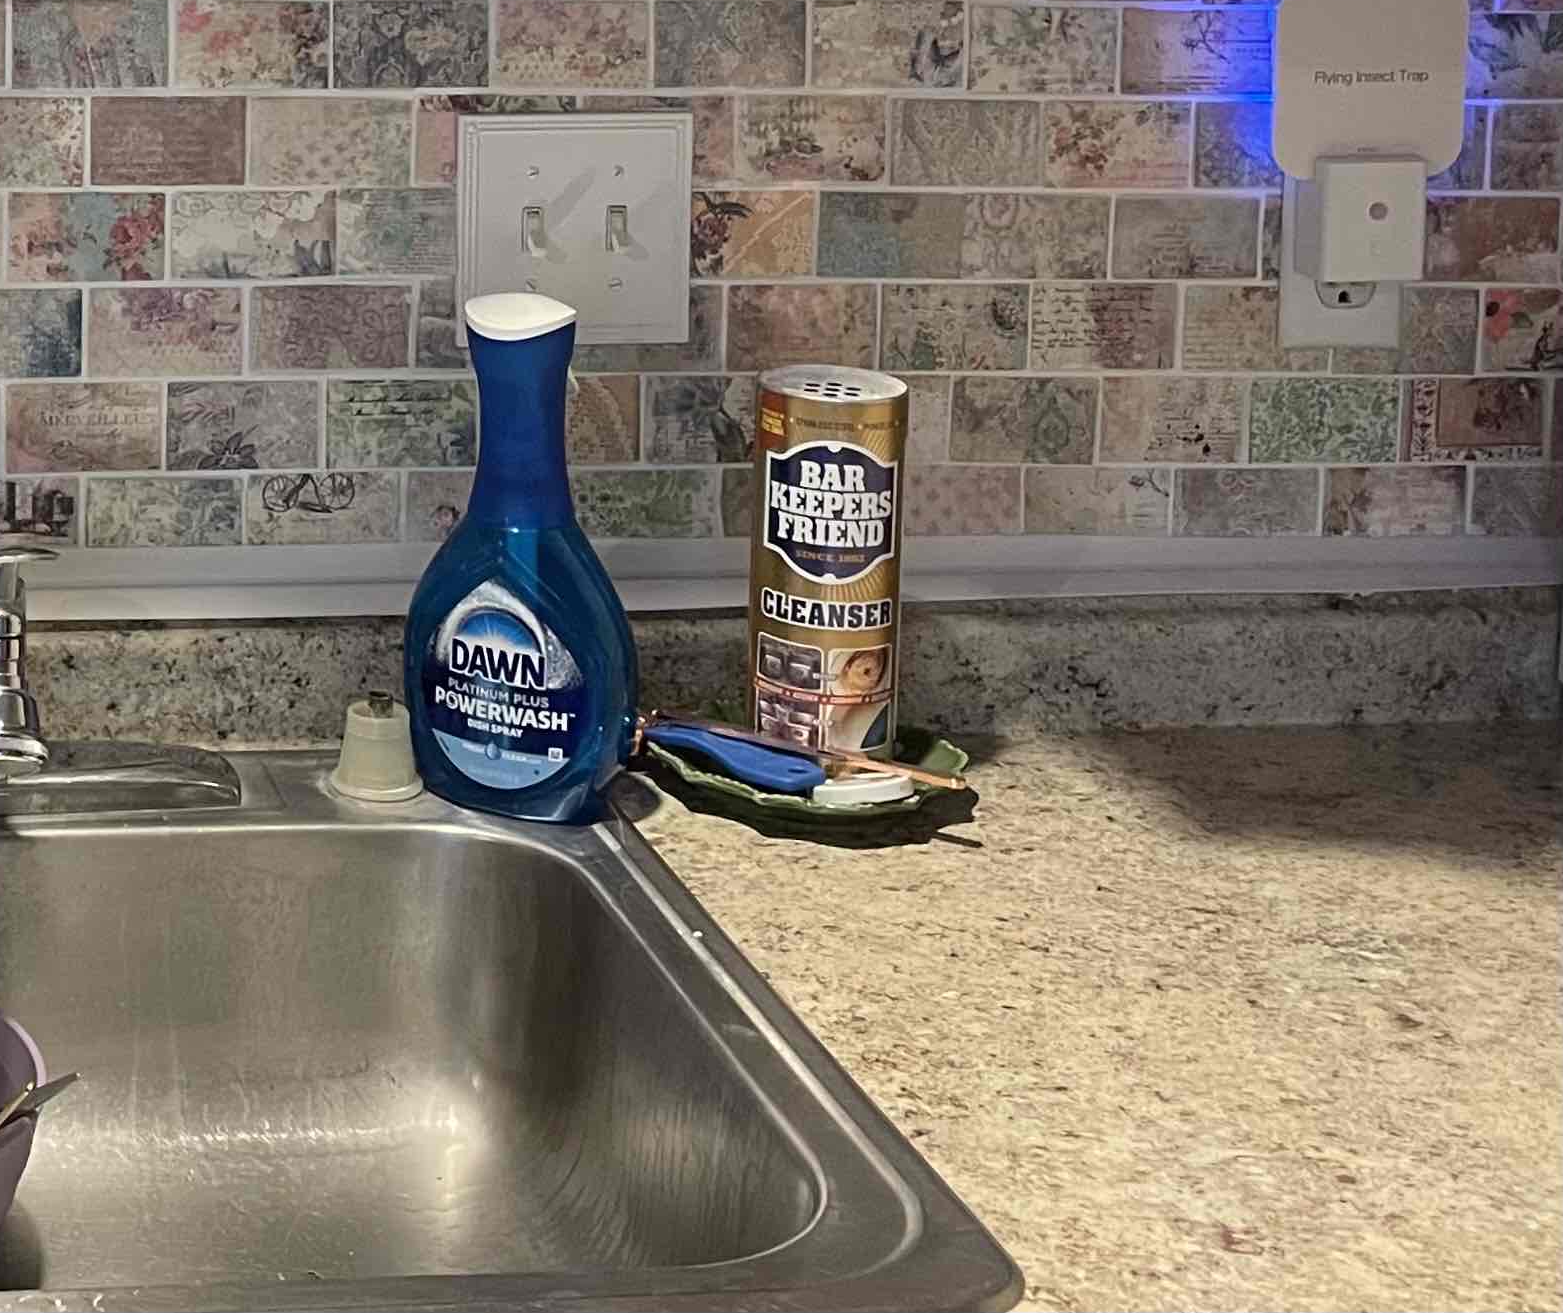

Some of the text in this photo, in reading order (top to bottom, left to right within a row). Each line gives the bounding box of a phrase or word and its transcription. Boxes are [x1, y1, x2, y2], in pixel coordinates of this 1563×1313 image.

[1314, 69, 1429, 86] Flying Insect Trap
[799, 460, 866, 492] BAR
[770, 480, 892, 520] KEEPERS
[777, 510, 885, 548] FRIEND
[762, 587, 892, 630] CLEANSER
[450, 636, 547, 690] DAWN
[448, 677, 550, 708] PLATINUM PLUS
[491, 722, 524, 738] SPRAY
